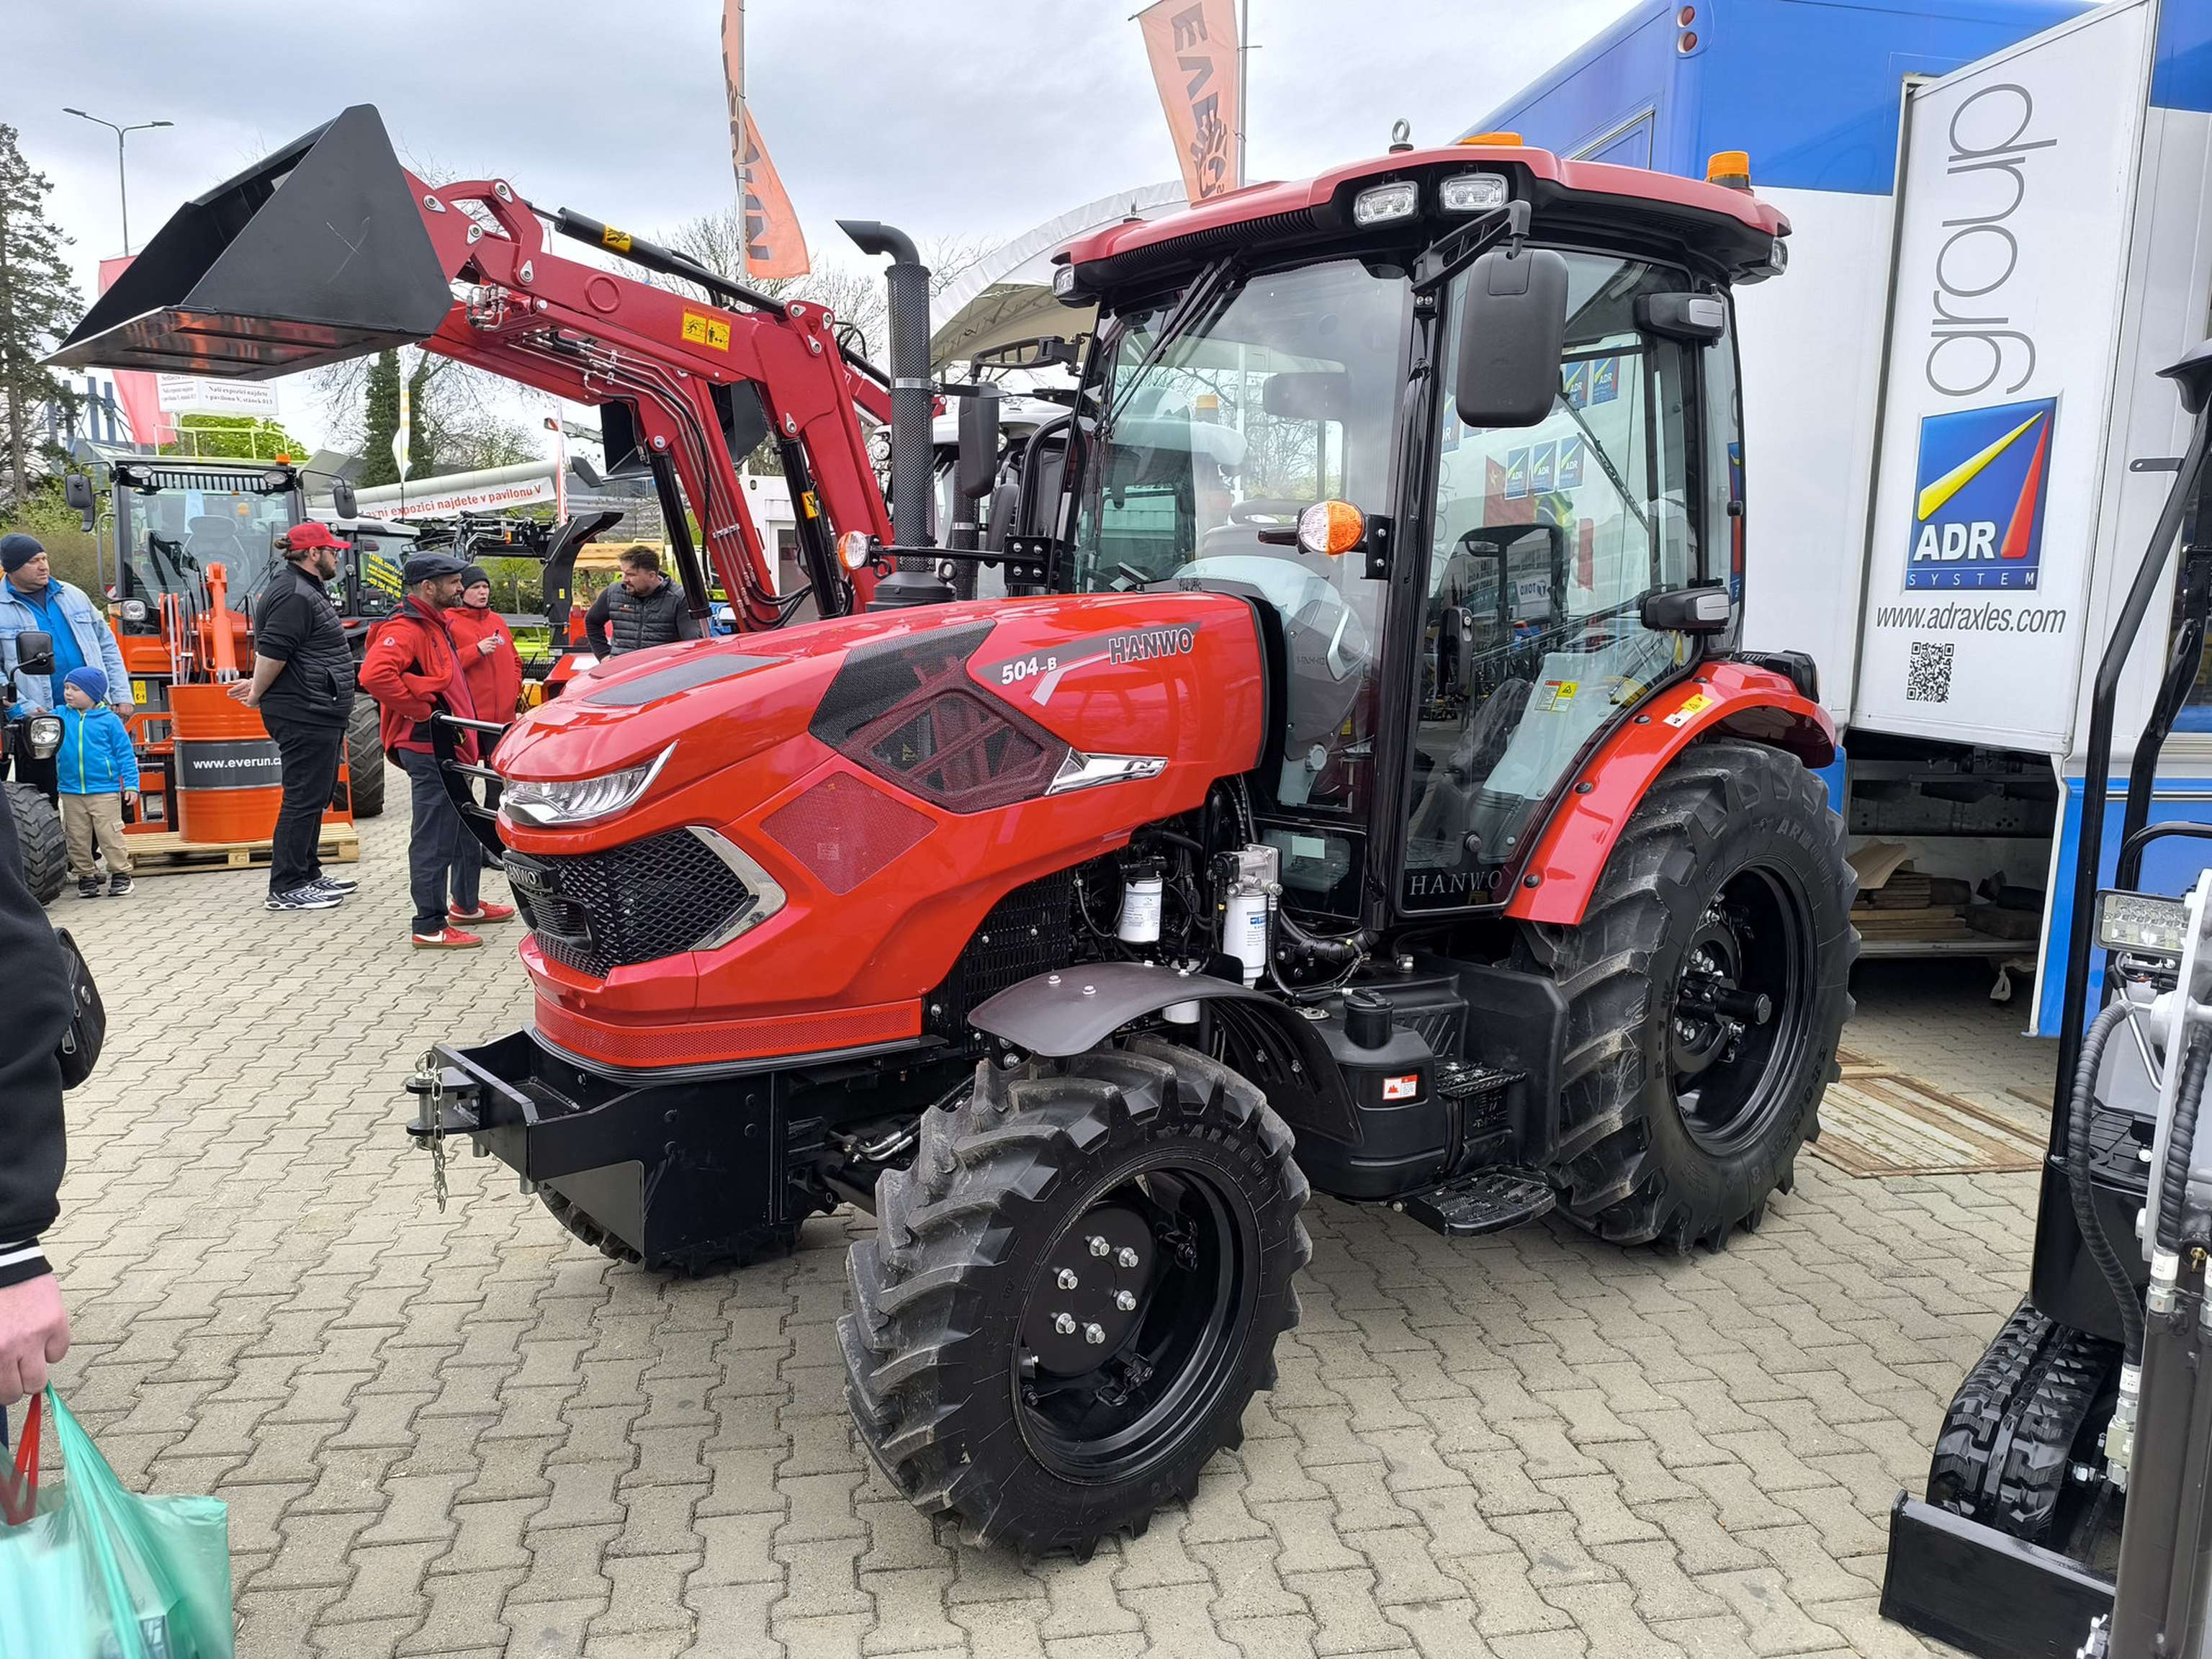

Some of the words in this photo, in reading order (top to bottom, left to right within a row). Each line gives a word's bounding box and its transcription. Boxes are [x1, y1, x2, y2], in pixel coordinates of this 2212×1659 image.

[1925, 83, 2057, 397] group
[391, 500, 433, 517] expozici
[437, 494, 479, 513] najdete
[488, 487, 533, 503] pavilonu
[534, 485, 541, 494] V
[1912, 521, 1996, 562] ADR
[1909, 572, 2035, 585] SYSTEM
[1876, 602, 2067, 634] www.adraxles.com
[1002, 657, 1057, 685] 504-B
[1109, 628, 1194, 665] HANWO
[1409, 870, 1503, 896] HANWO
